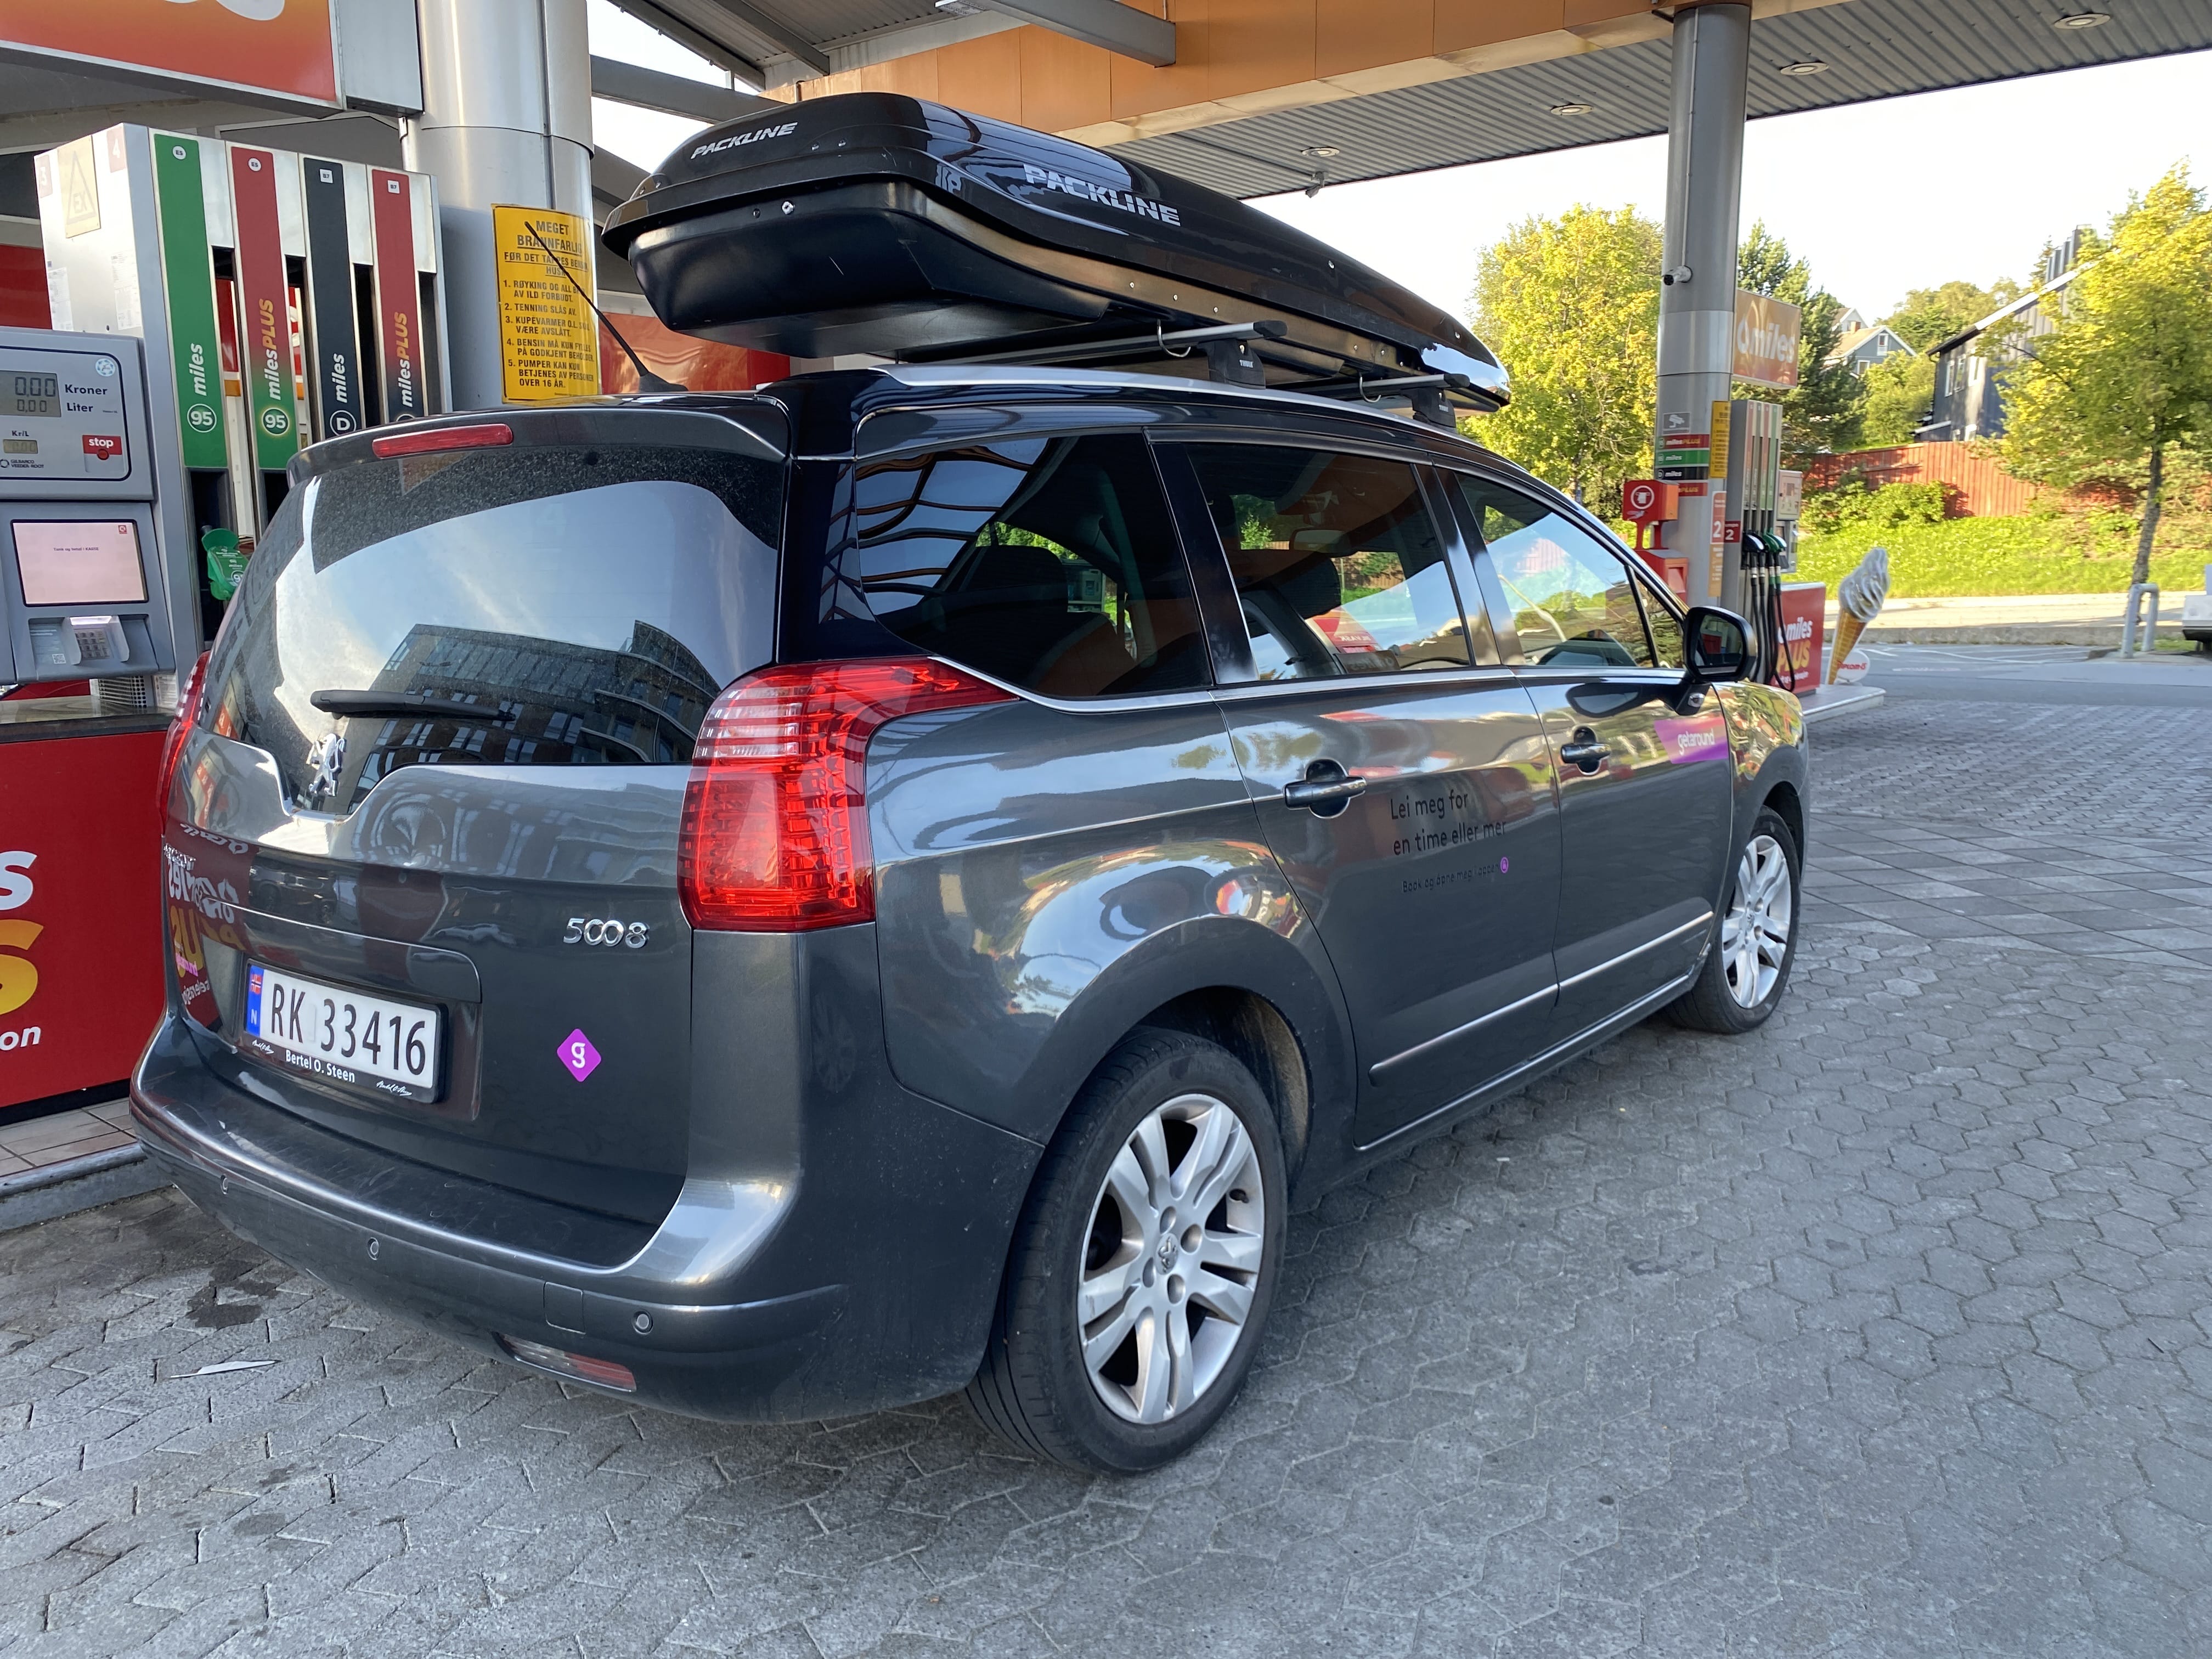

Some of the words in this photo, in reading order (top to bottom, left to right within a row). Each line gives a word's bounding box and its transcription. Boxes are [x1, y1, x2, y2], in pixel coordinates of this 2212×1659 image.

[112, 138, 121, 159] 4
[691, 122, 799, 160] PACKLINE
[1022, 163, 1182, 226] PACKLINE
[535, 221, 569, 235] MEGET
[517, 234, 582, 253] BRANNFARLIG
[504, 252, 521, 261] FØR
[524, 253, 540, 262] DET
[503, 279, 511, 287] 1.
[514, 280, 547, 290] RØYKING
[550, 283, 559, 291] OG
[561, 284, 572, 293] ALL
[541, 291, 573, 302] FORBUDT.
[514, 303, 548, 313] TENNING
[550, 304, 567, 315] SLÅS
[568, 308, 577, 316] AV.
[505, 315, 513, 324] 3.
[567, 320, 578, 329] O.L.
[516, 325, 539, 334] VÆRE
[541, 326, 572, 337] AVSLÅTT.
[258, 298, 281, 401] milesPLUS
[517, 338, 545, 347] BENSIN
[548, 339, 559, 348] MÅ
[561, 341, 573, 350] KUN
[1748, 322, 1796, 364] miles
[394, 311, 413, 408] milesPLUS
[517, 348, 527, 356] PÅ
[530, 348, 567, 359] GODKJENT
[188, 342, 207, 397] miles
[508, 359, 516, 367] 5.
[518, 359, 551, 368] PUMPER
[553, 362, 567, 370] KAN
[568, 363, 580, 371] KUN
[331, 353, 348, 404] miles
[519, 369, 557, 378] BETJENES
[569, 372, 594, 382] PERSONER
[519, 378, 540, 387] OVER
[543, 379, 552, 387] 16
[554, 378, 566, 388] ÅR.
[64, 384, 108, 396] Kroner
[66, 402, 93, 413] Liter
[190, 410, 213, 426] 95
[264, 414, 287, 430] 95
[336, 417, 351, 431] D
[88, 437, 114, 448] stop
[1713, 520, 1722, 538] 2
[1725, 529, 1734, 540] 2
[1786, 616, 1813, 642] miles
[1776, 640, 1811, 673] PLUS
[1678, 728, 1716, 756] getaround
[1390, 795, 1410, 820] Lei
[1415, 798, 1445, 819] meg
[1448, 789, 1468, 810] for
[1393, 838, 1410, 856] en
[1414, 828, 1447, 851] time
[1452, 822, 1479, 844] eller
[1482, 821, 1506, 839] mer
[1402, 878, 1422, 893] Book
[1424, 878, 1434, 891] og
[563, 917, 650, 949] 5008
[251, 1008, 257, 1025] N
[271, 983, 306, 1043] RK
[320, 998, 426, 1076] 33416
[572, 1041, 585, 1068] g
[285, 1049, 313, 1070] Bertel
[313, 1059, 325, 1074] O.
[326, 1063, 356, 1083] Steen
